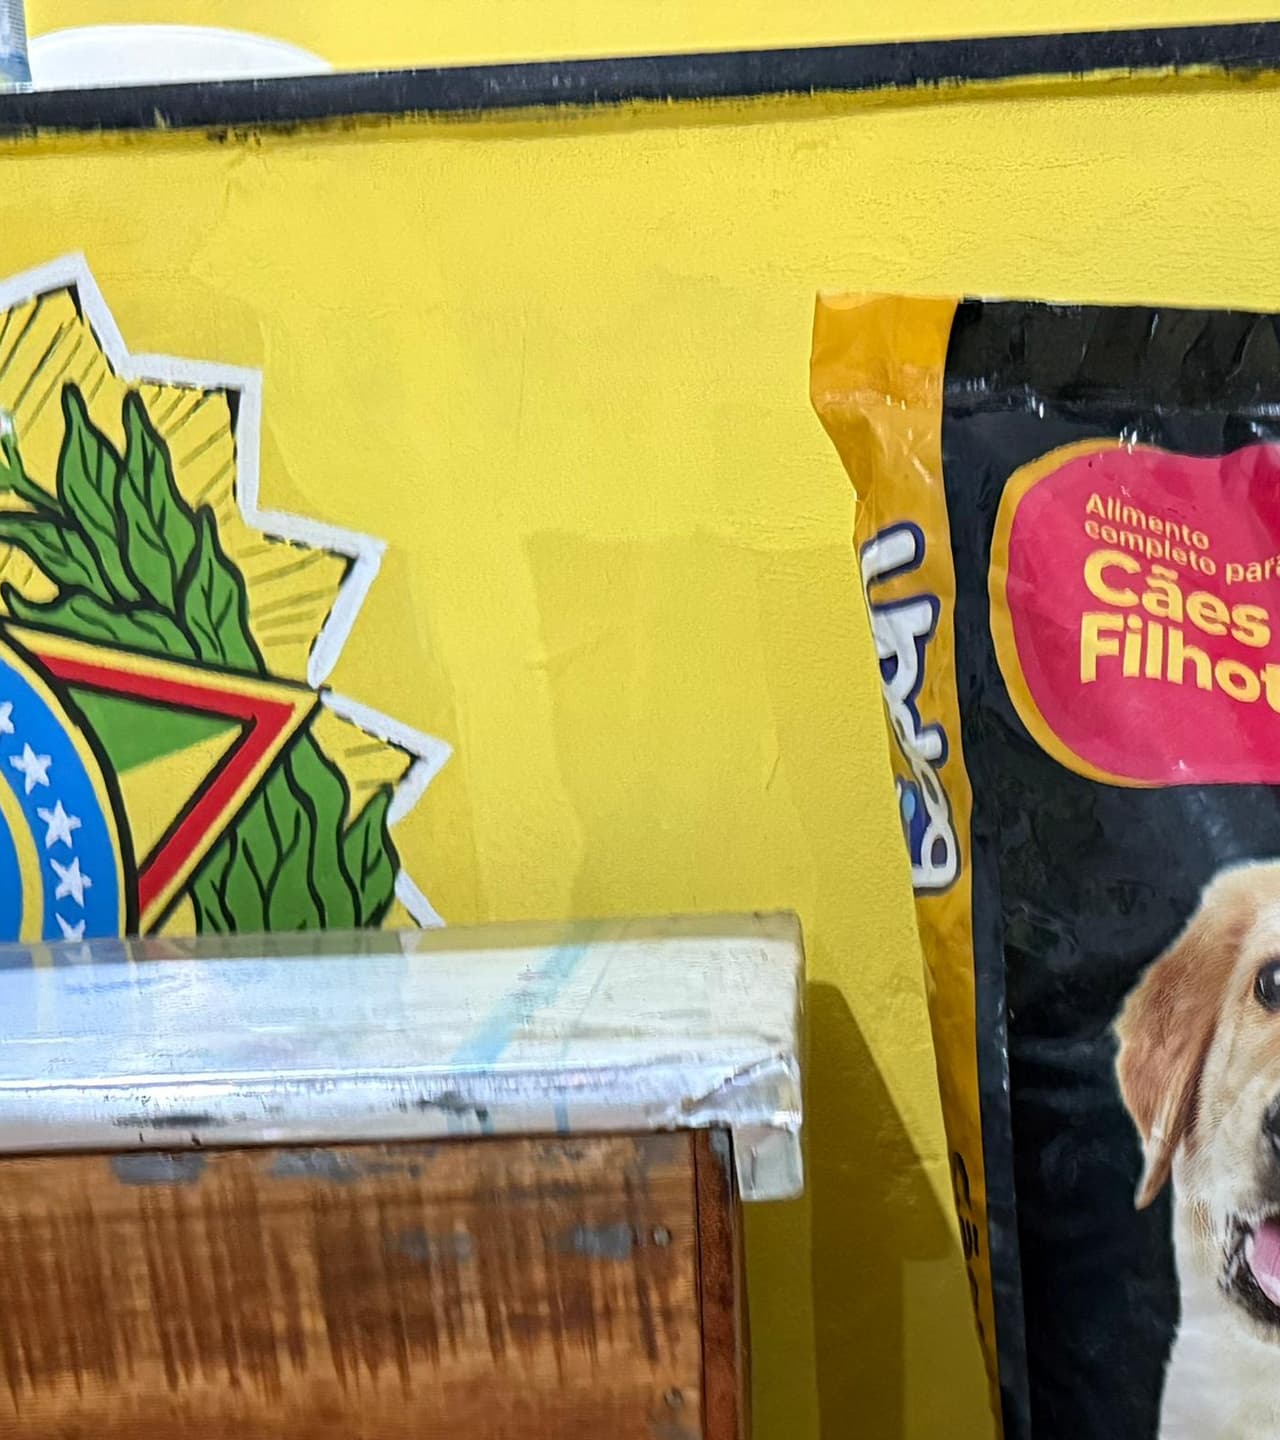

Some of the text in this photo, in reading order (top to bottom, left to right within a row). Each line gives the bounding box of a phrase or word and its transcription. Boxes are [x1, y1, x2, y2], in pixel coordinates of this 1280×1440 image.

[1084, 519, 1217, 576] completo
[1085, 493, 1209, 550] Alimento
[1083, 549, 1272, 648] Cães
